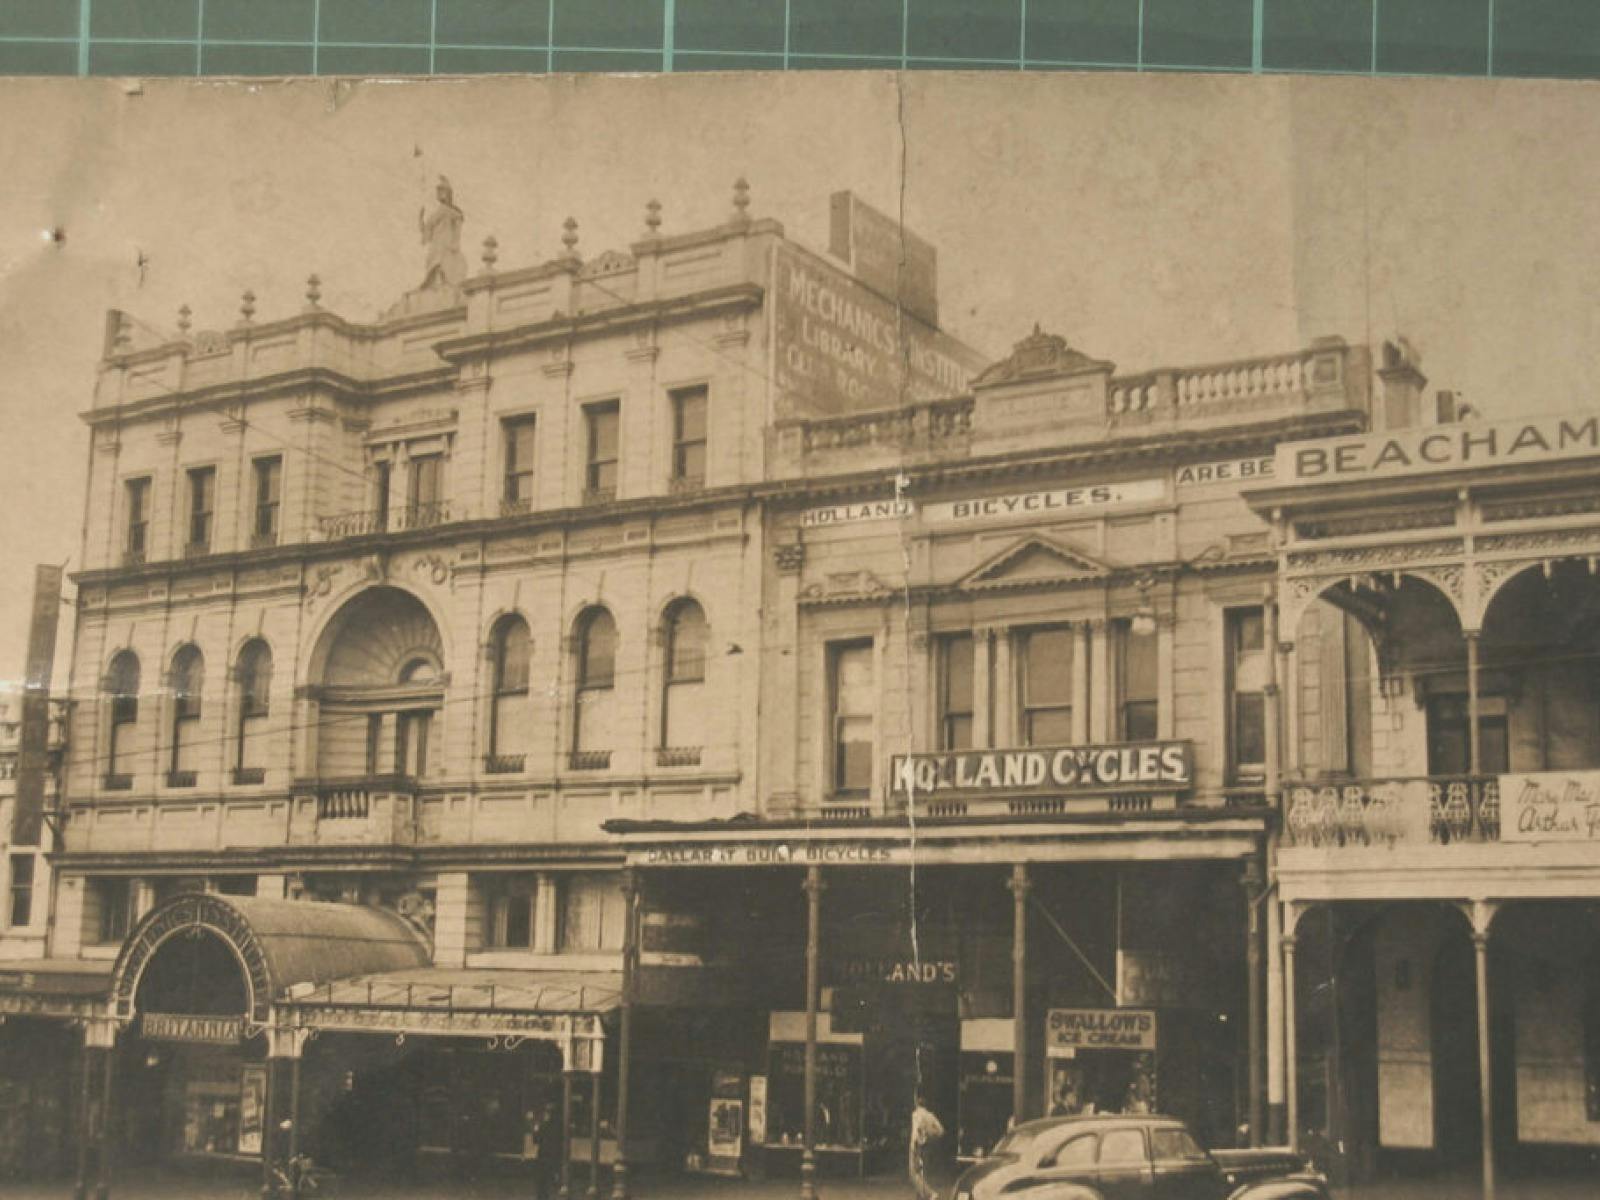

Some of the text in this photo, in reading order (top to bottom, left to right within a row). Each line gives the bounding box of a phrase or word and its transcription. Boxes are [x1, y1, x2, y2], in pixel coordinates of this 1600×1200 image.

[1295, 417, 1598, 479] BEACHAM
[802, 502, 910, 526] HOLLAND
[1178, 463, 1233, 484] ARE
[1240, 457, 1275, 479] BE
